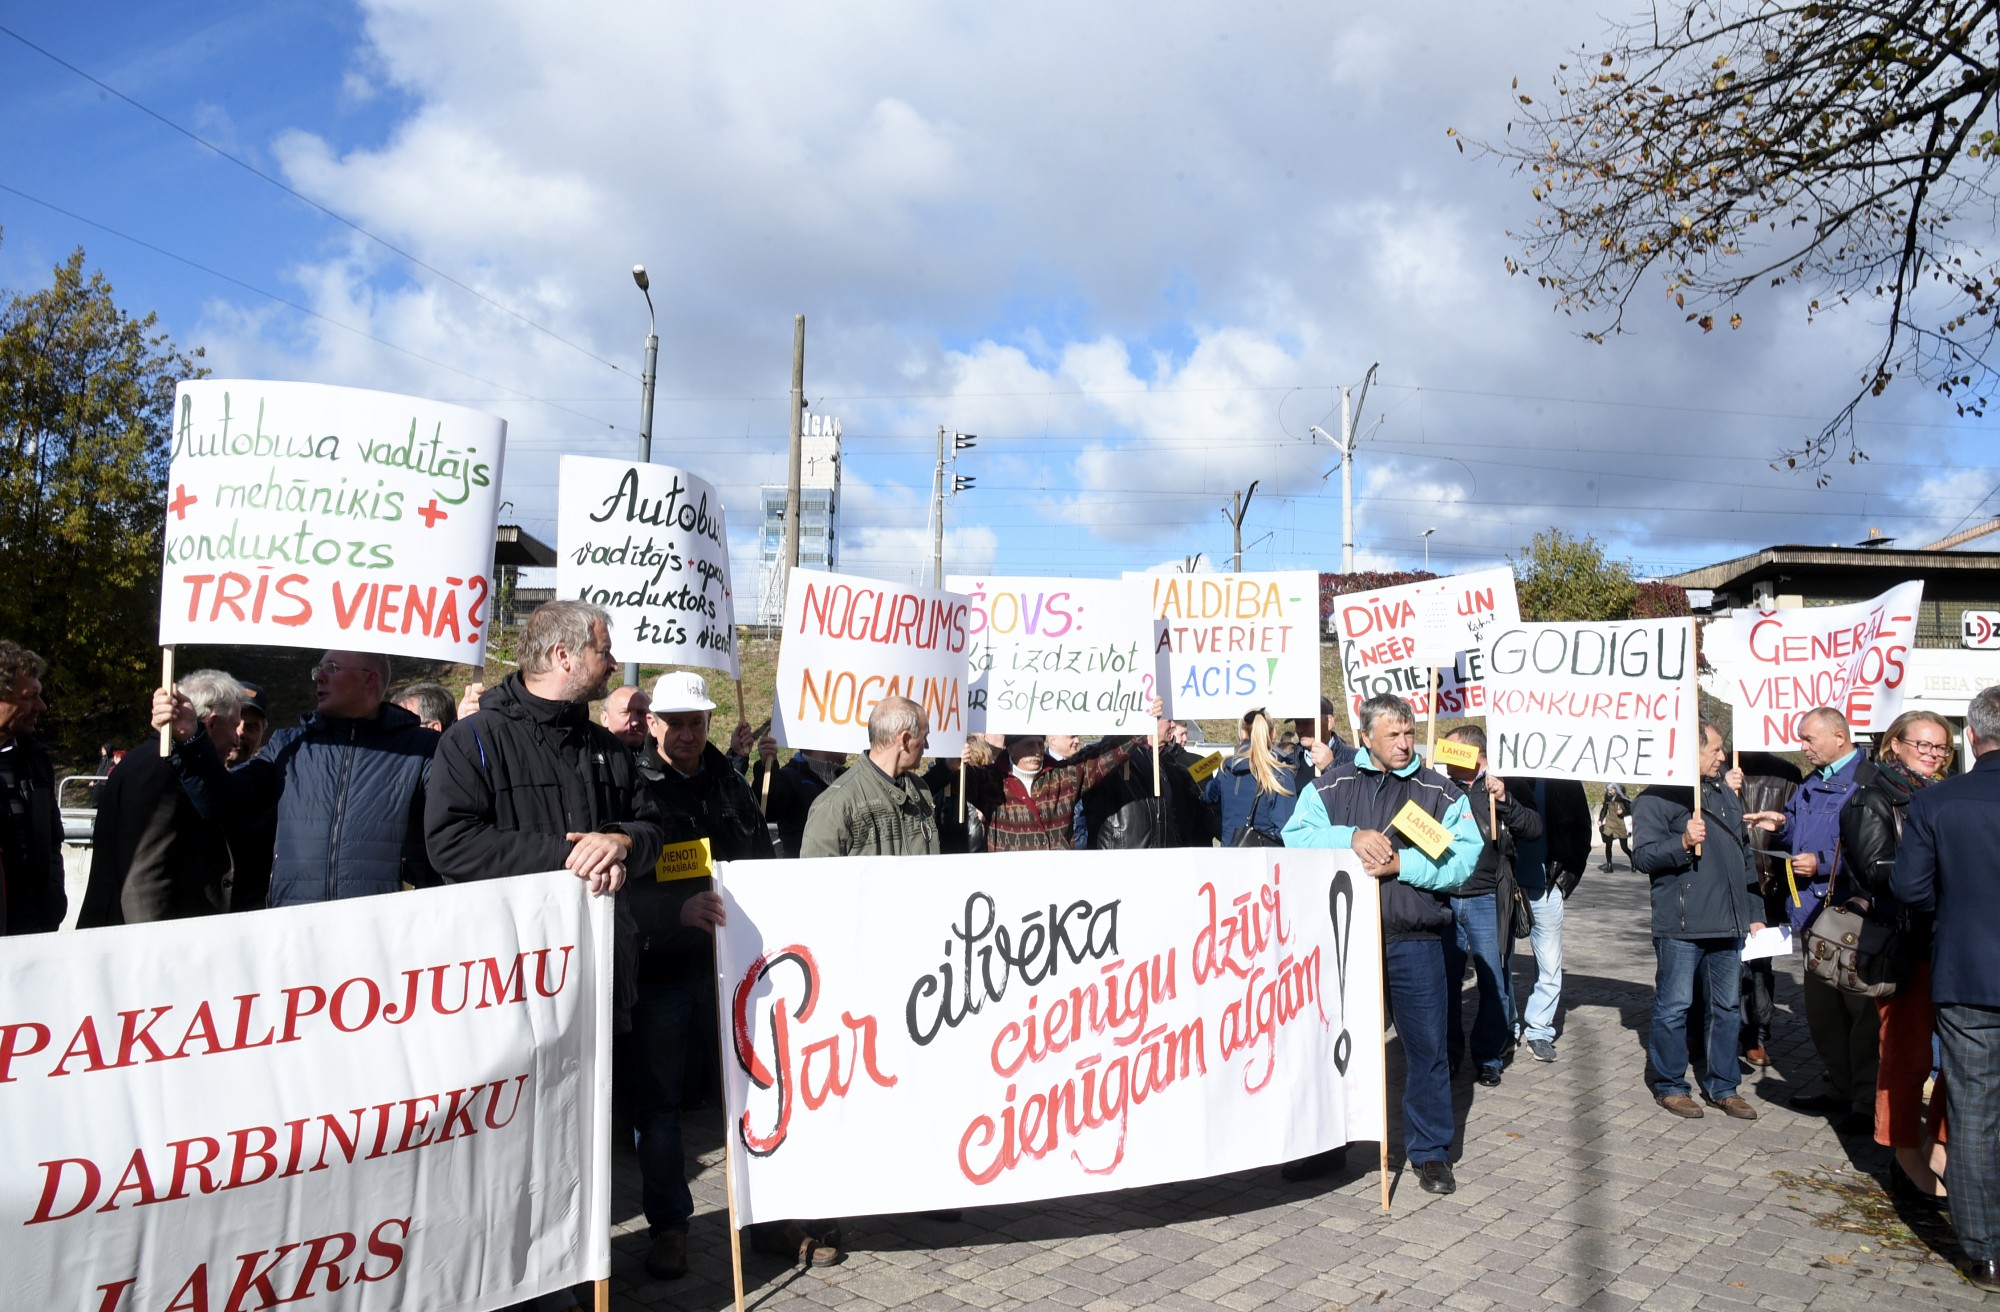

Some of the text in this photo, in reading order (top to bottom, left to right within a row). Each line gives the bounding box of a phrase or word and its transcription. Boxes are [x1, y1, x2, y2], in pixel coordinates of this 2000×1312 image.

[171, 391, 490, 505] Autobusa vadītājs
[571, 535, 682, 586] vadītājs
[183, 565, 489, 644] TRĪS VIENĀ?
[799, 583, 967, 654] NOGURUMS
[968, 582, 1084, 637] ŠOVS:
[1343, 597, 1415, 638] DĪVA
[1457, 587, 1494, 616] UN
[1012, 641, 1138, 674] izdzīvot
[1360, 636, 1415, 667] NEĒR
[1453, 648, 1485, 685] LĒ
[1491, 624, 1686, 681] GODĪGU
[1924, 675, 1970, 691] IEEJA
[1441, 746, 1472, 759] LAKRS
[1406, 811, 1442, 843] LAKRS
[661, 848, 698, 863] VIENOTI
[0, 945, 574, 1083] PAKALPOJUMU
[732, 891, 1121, 1158] Par cilvēka
[991, 947, 1177, 1078] cienīgu
[958, 1016, 1207, 1186] cienīgām
[24, 1074, 528, 1225] DARBINIEKU
